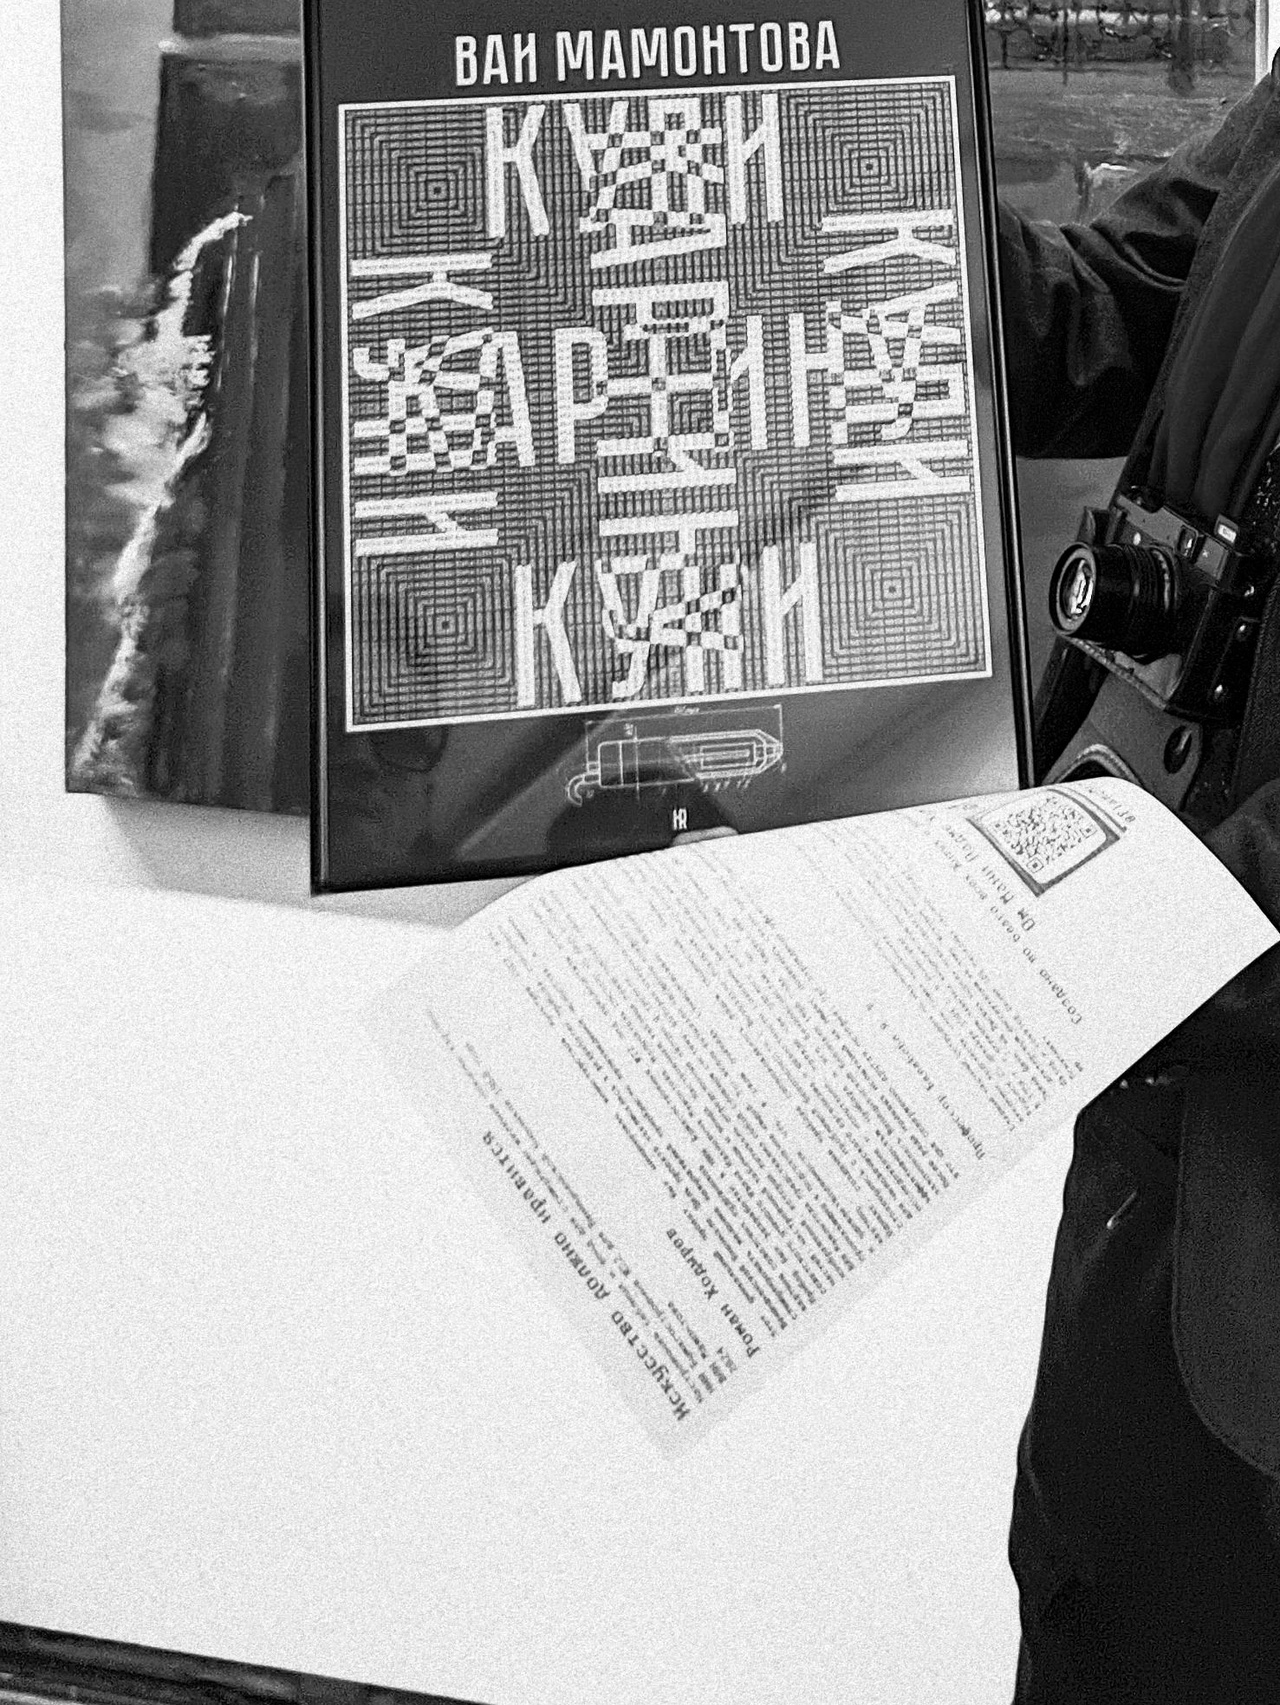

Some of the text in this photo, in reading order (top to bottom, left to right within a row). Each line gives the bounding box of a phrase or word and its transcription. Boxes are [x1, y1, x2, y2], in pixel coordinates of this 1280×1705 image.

[454, 19, 841, 87] ВАИ МАМОНТОВА
[977, 863, 1015, 905] Мани
[1012, 905, 1037, 933] Ом
[1035, 966, 1085, 1026] Создано
[933, 1090, 988, 1161] Профессор
[479, 1126, 696, 1421] Искусство должно нравится
[661, 1224, 761, 1358] Роман Ходырев
